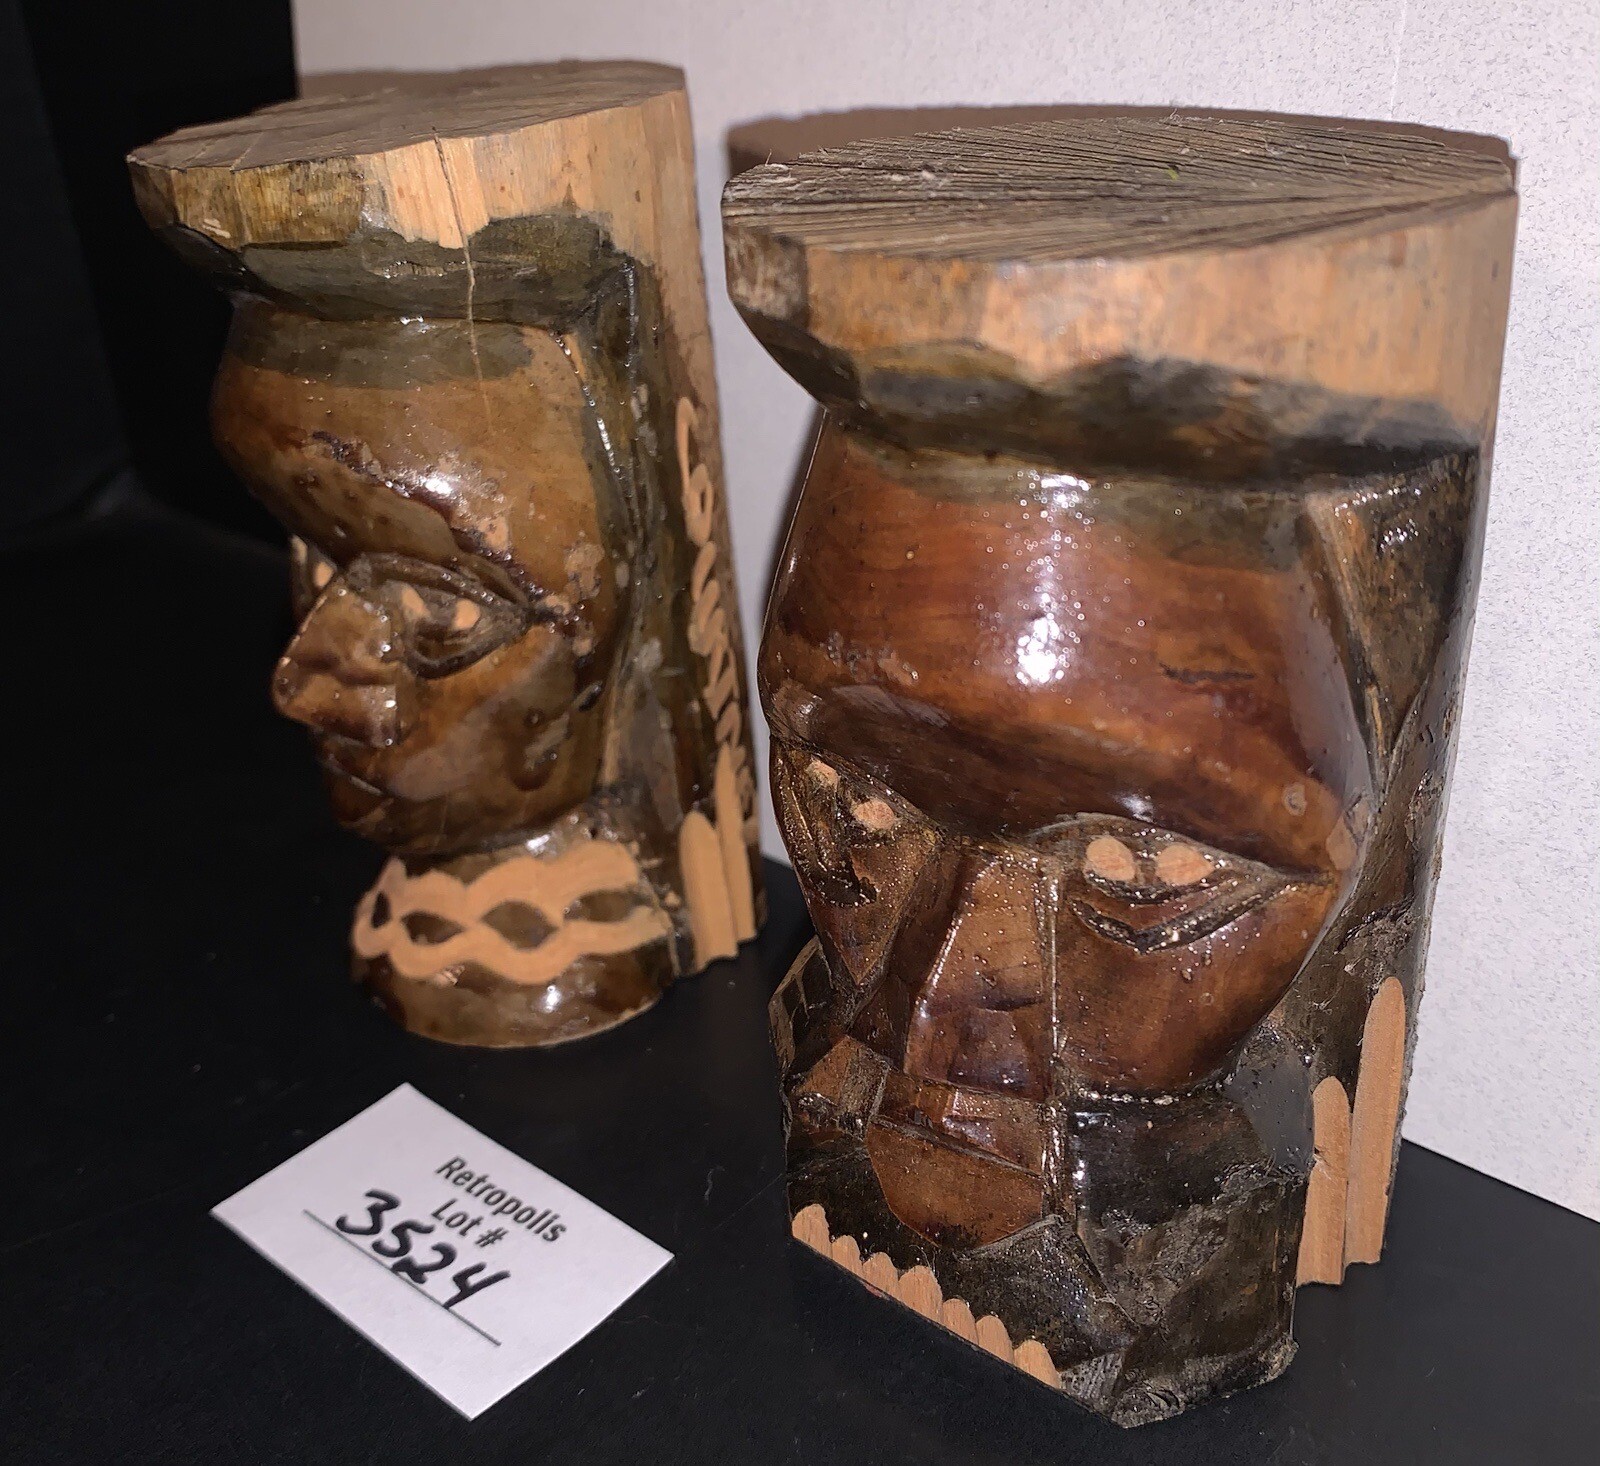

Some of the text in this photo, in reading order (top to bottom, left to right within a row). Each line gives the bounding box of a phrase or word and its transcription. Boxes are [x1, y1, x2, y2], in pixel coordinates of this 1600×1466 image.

[431, 1199, 508, 1248] Lot #
[436, 1157, 566, 1242] Retropolis
[335, 1190, 510, 1310] 3524
